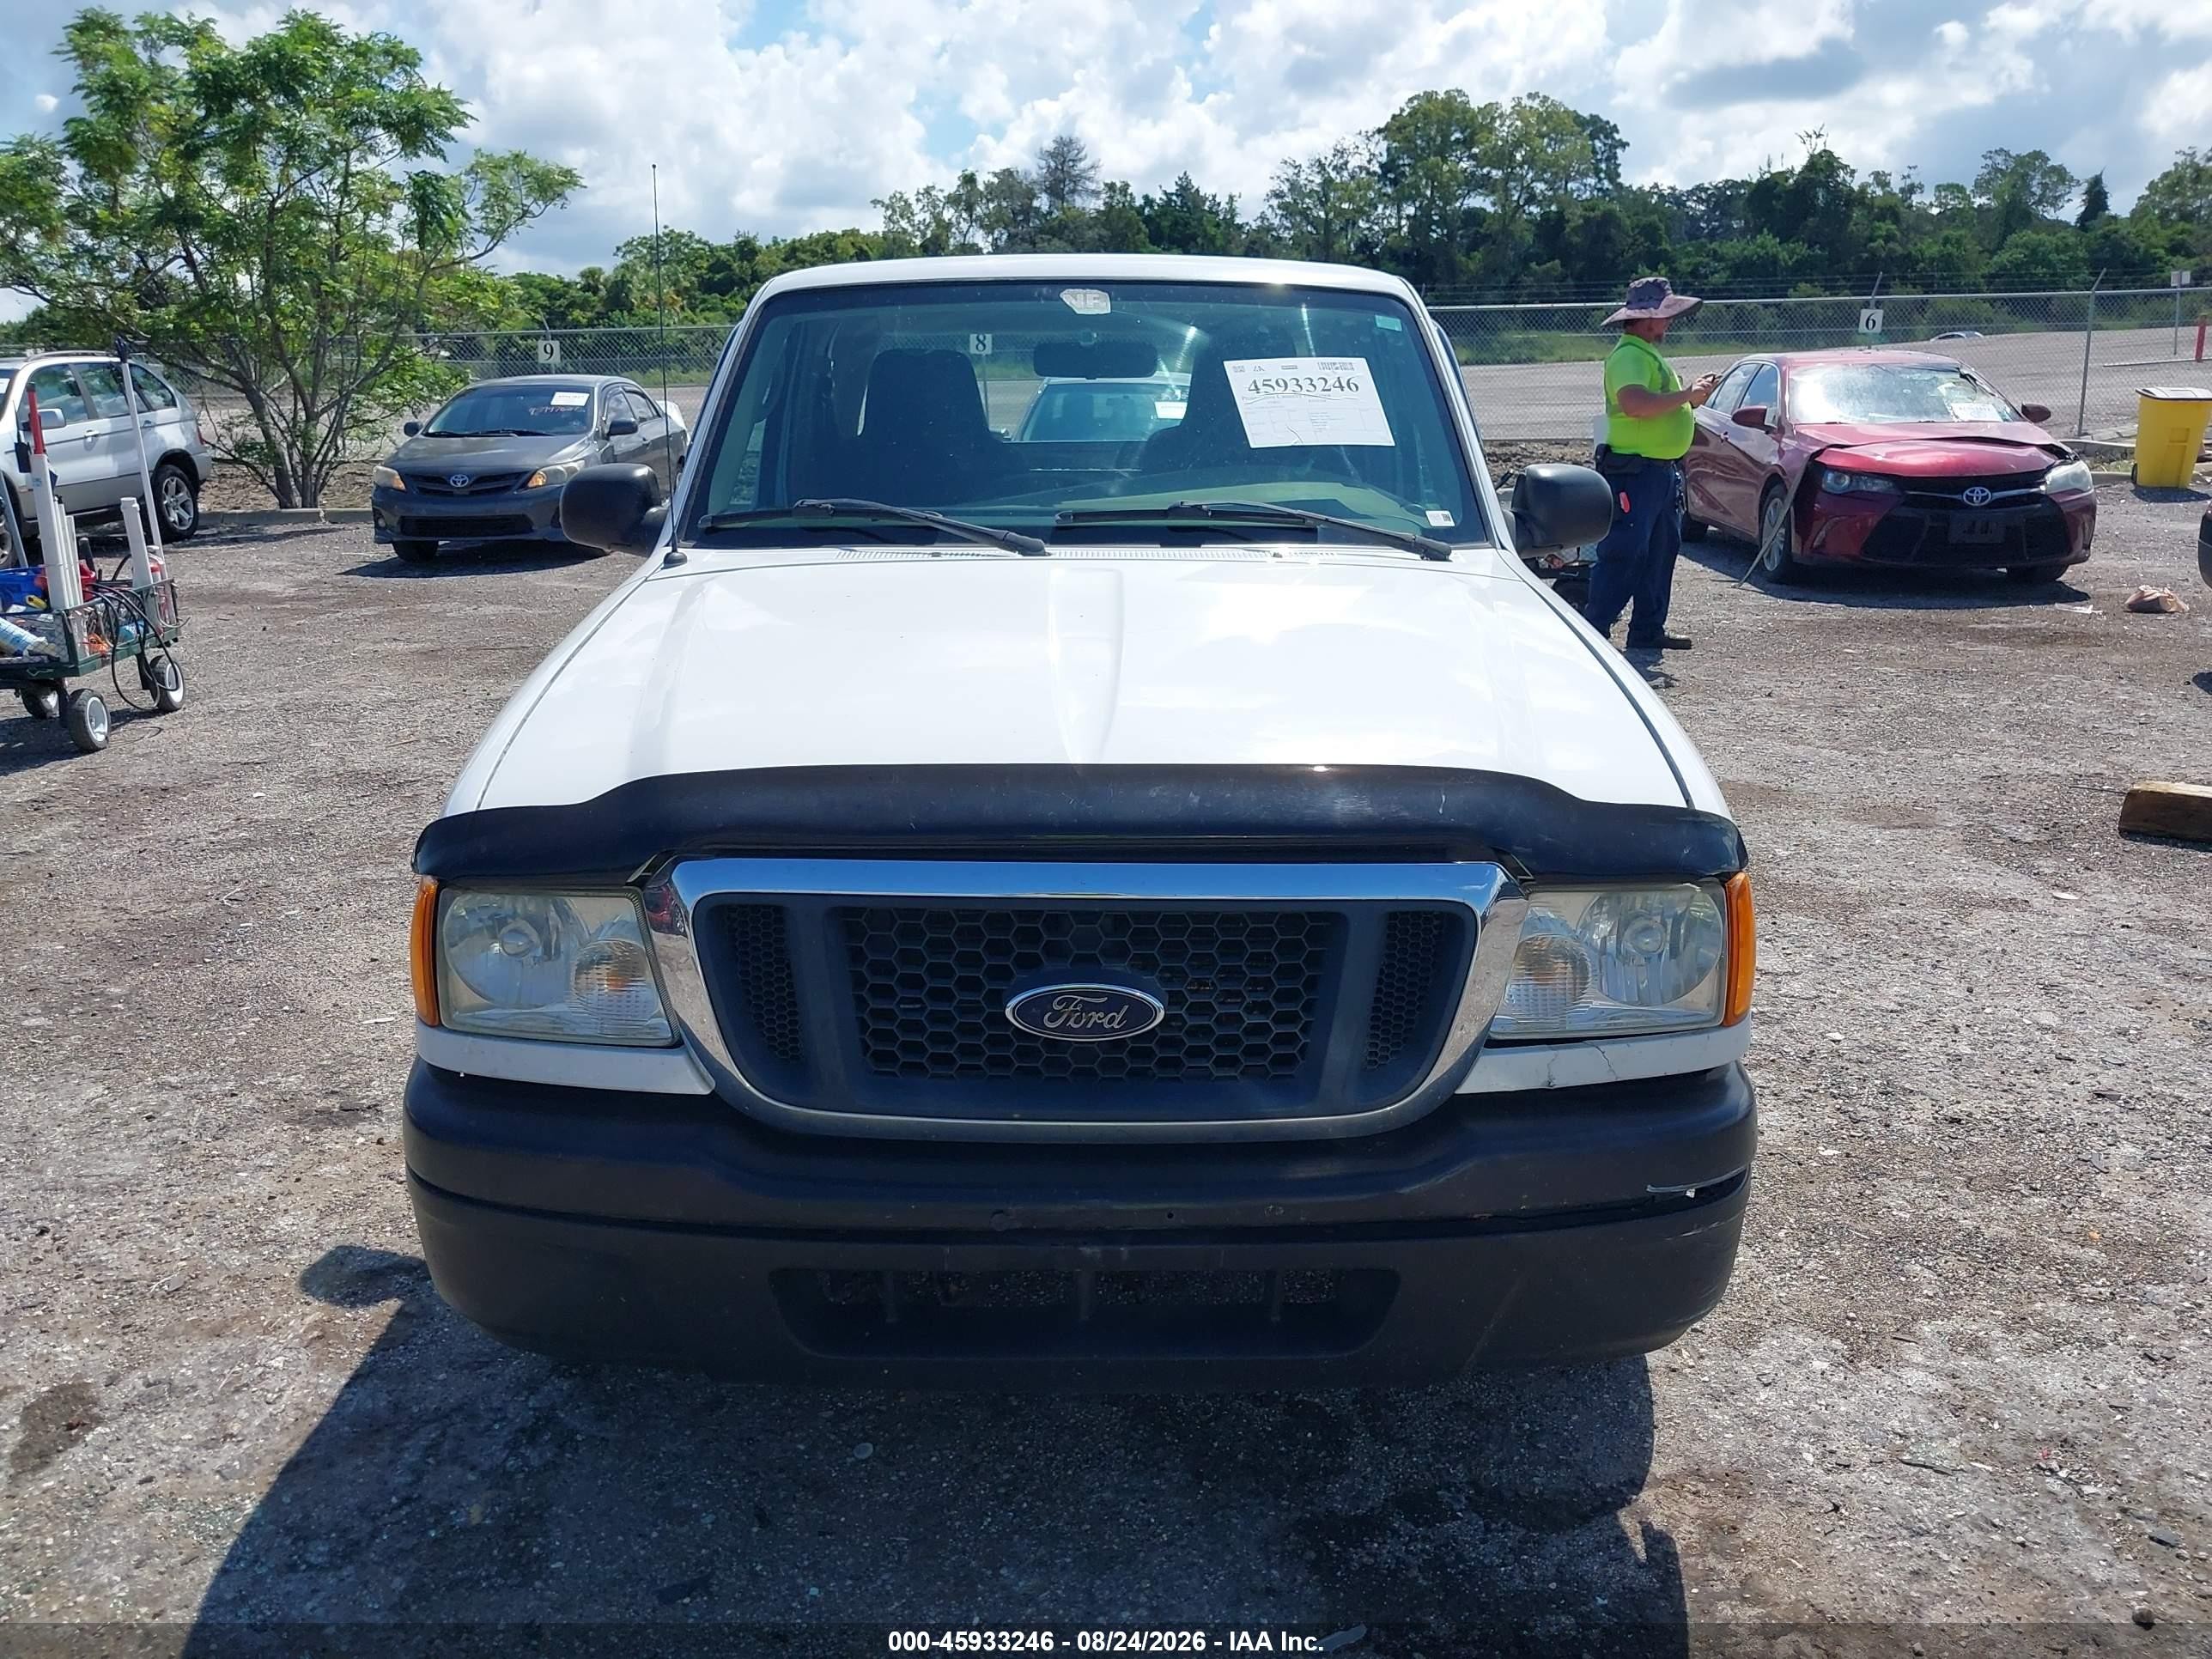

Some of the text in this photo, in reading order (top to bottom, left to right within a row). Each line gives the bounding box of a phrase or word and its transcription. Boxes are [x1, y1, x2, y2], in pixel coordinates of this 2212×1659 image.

[1865, 312, 1876, 331] 6
[975, 333, 986, 352] 8
[543, 343, 554, 362] 9
[1248, 376, 1359, 394] 45933246
[1043, 994, 1129, 1029] Ford
